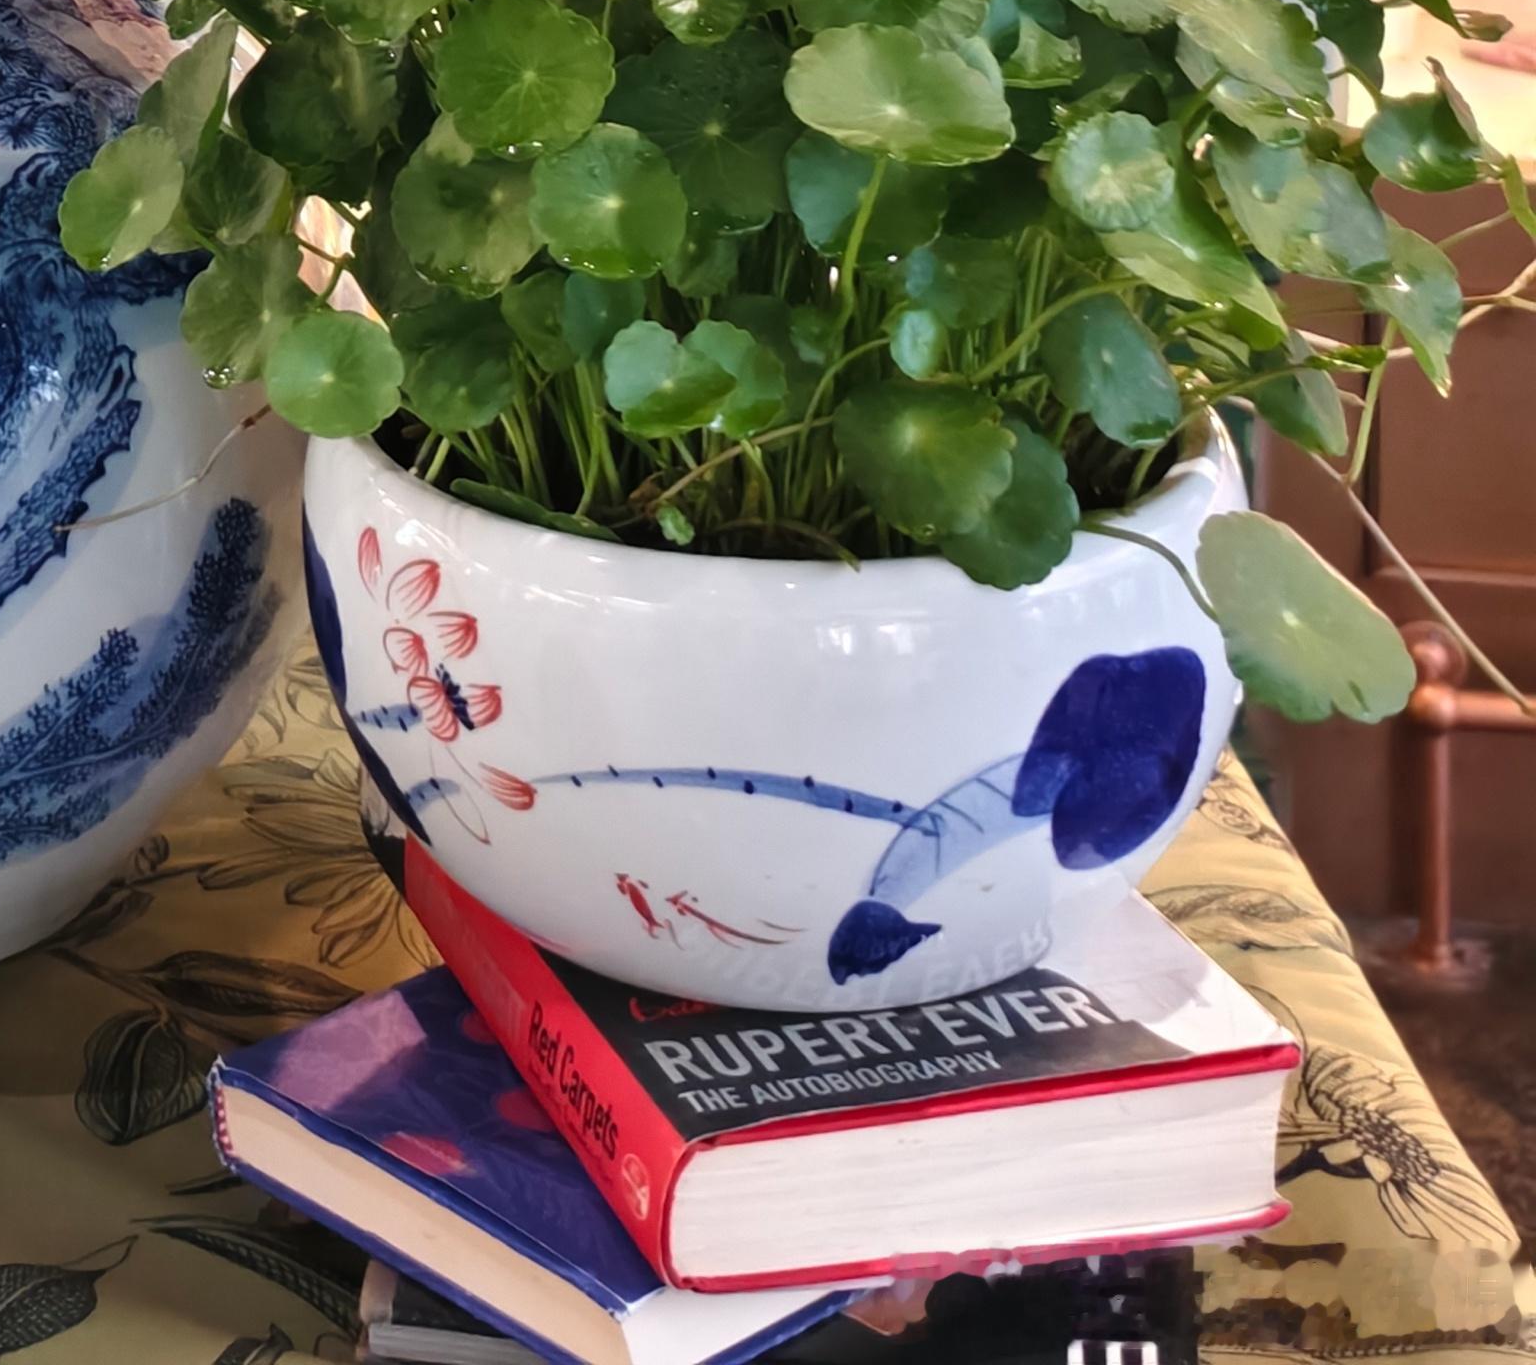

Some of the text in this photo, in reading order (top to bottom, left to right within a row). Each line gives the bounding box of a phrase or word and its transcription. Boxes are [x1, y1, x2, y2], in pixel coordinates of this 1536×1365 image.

[528, 1000, 562, 1076] Red
[560, 1044, 618, 1161] Carpets
[645, 1012, 916, 1084] RUPERT
[677, 1050, 1003, 1115] THE AUTOBIOGRAPHY
